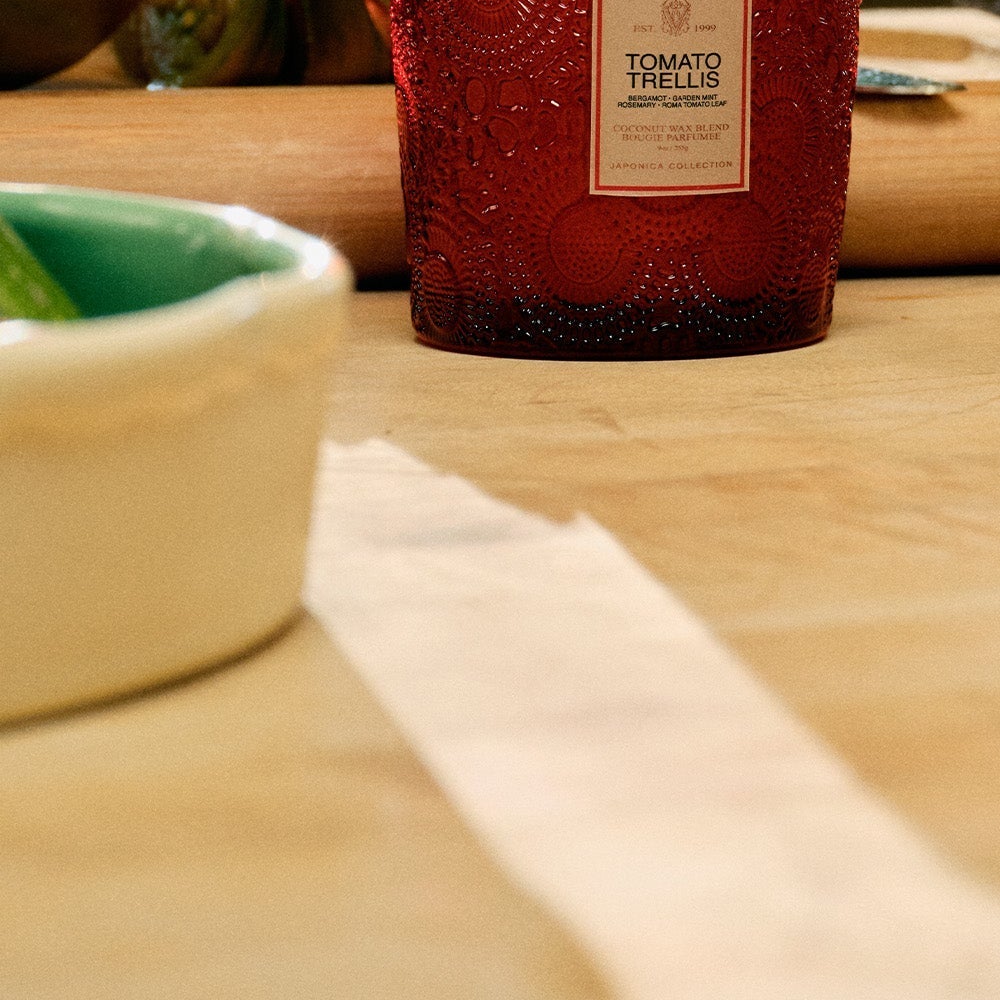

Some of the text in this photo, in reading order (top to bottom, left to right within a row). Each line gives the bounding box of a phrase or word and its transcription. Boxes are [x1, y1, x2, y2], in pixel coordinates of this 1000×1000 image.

[694, 24, 717, 33] 1999
[625, 53, 722, 70] TOMATO
[626, 71, 720, 89] TRELLIS
[613, 123, 730, 133] COCONUT WAX BLEND
[622, 133, 663, 142] BOUGIE
[610, 160, 733, 171] JAPONICA COLLECTION
